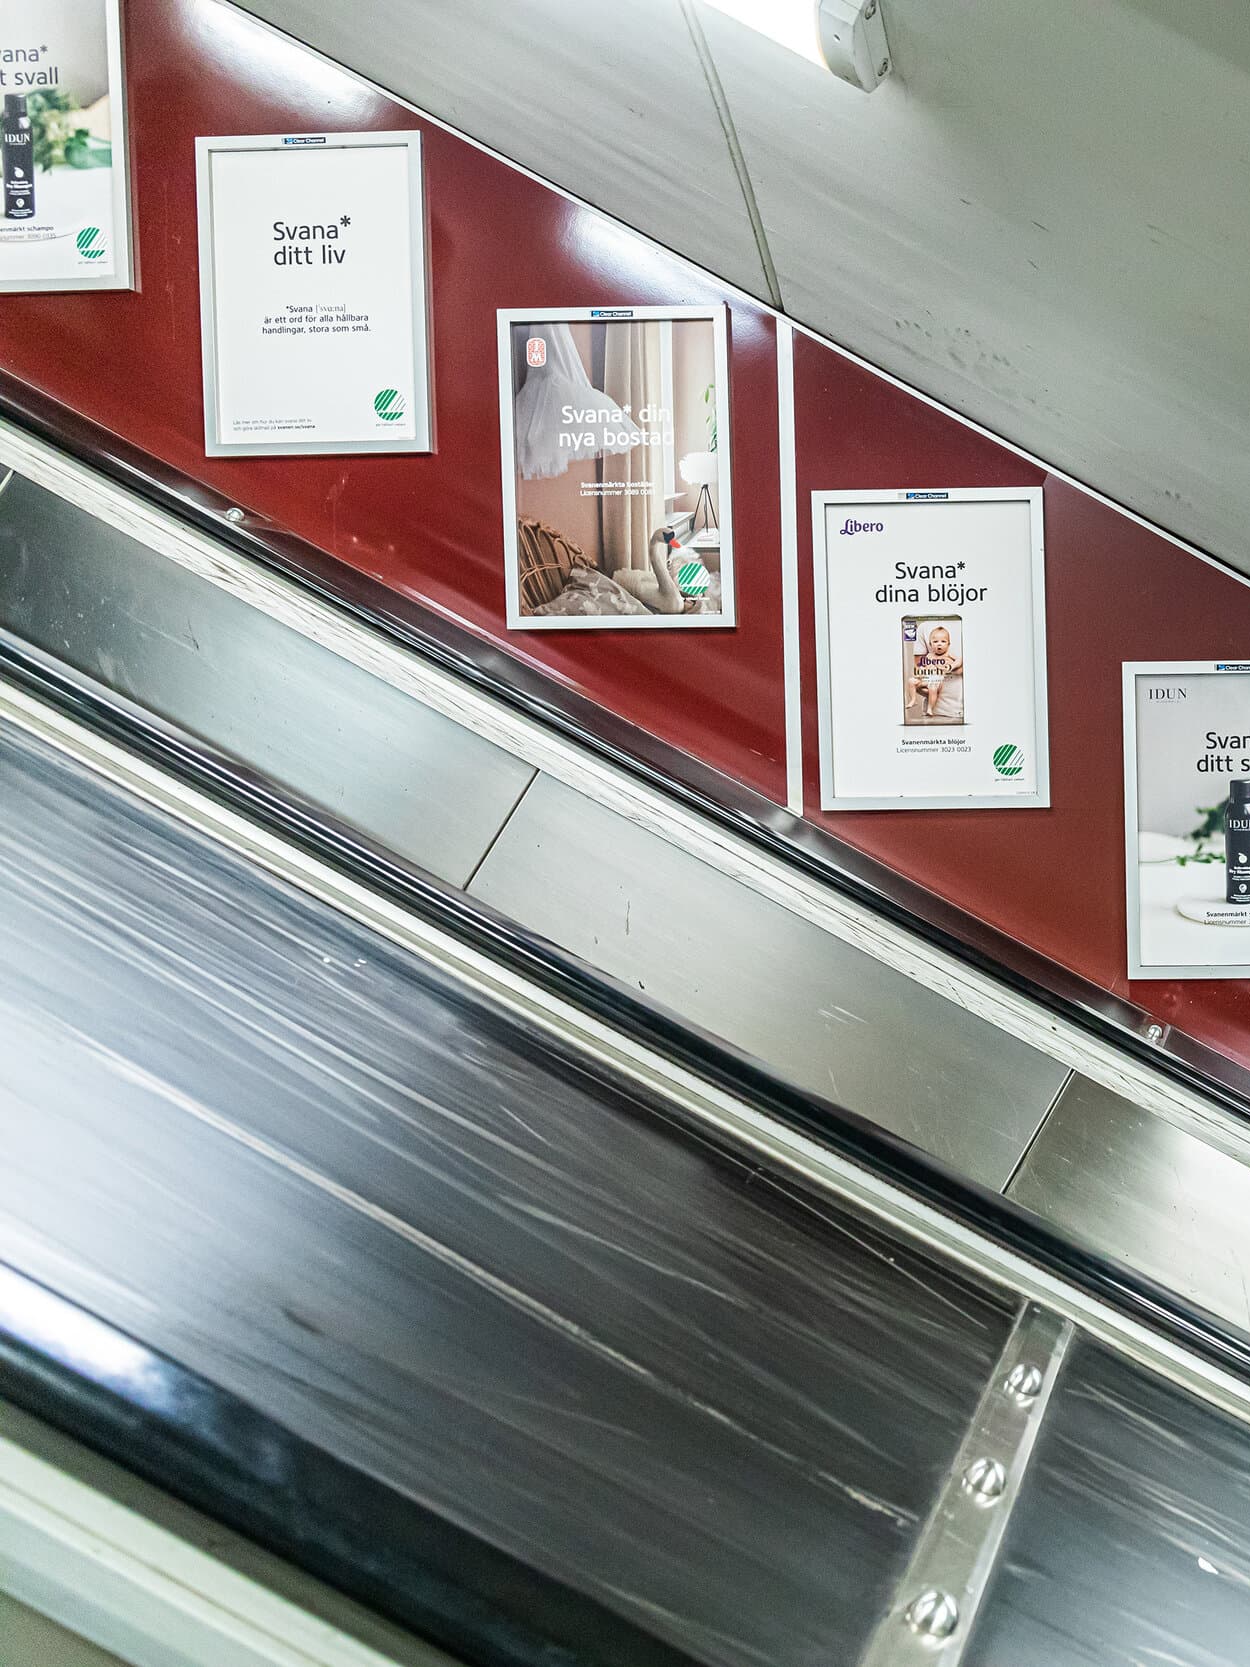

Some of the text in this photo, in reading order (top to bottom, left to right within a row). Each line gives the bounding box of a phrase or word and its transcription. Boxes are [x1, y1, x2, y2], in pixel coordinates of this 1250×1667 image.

[0, 45, 48, 62] ana
[15, 67, 58, 85] svall
[4, 133, 30, 143] IDUN
[274, 245, 346, 265] ditt liv
[264, 315, 272, 324] är
[306, 315, 316, 323] för
[336, 314, 369, 322] hållbara
[262, 327, 306, 335] handlingar,
[638, 404, 671, 422] din
[560, 432, 595, 451] nya
[840, 519, 884, 535] Libero
[875, 584, 988, 606] dina blöjor
[1149, 688, 1187, 700] IDUN
[1197, 754, 1233, 772] ditt
